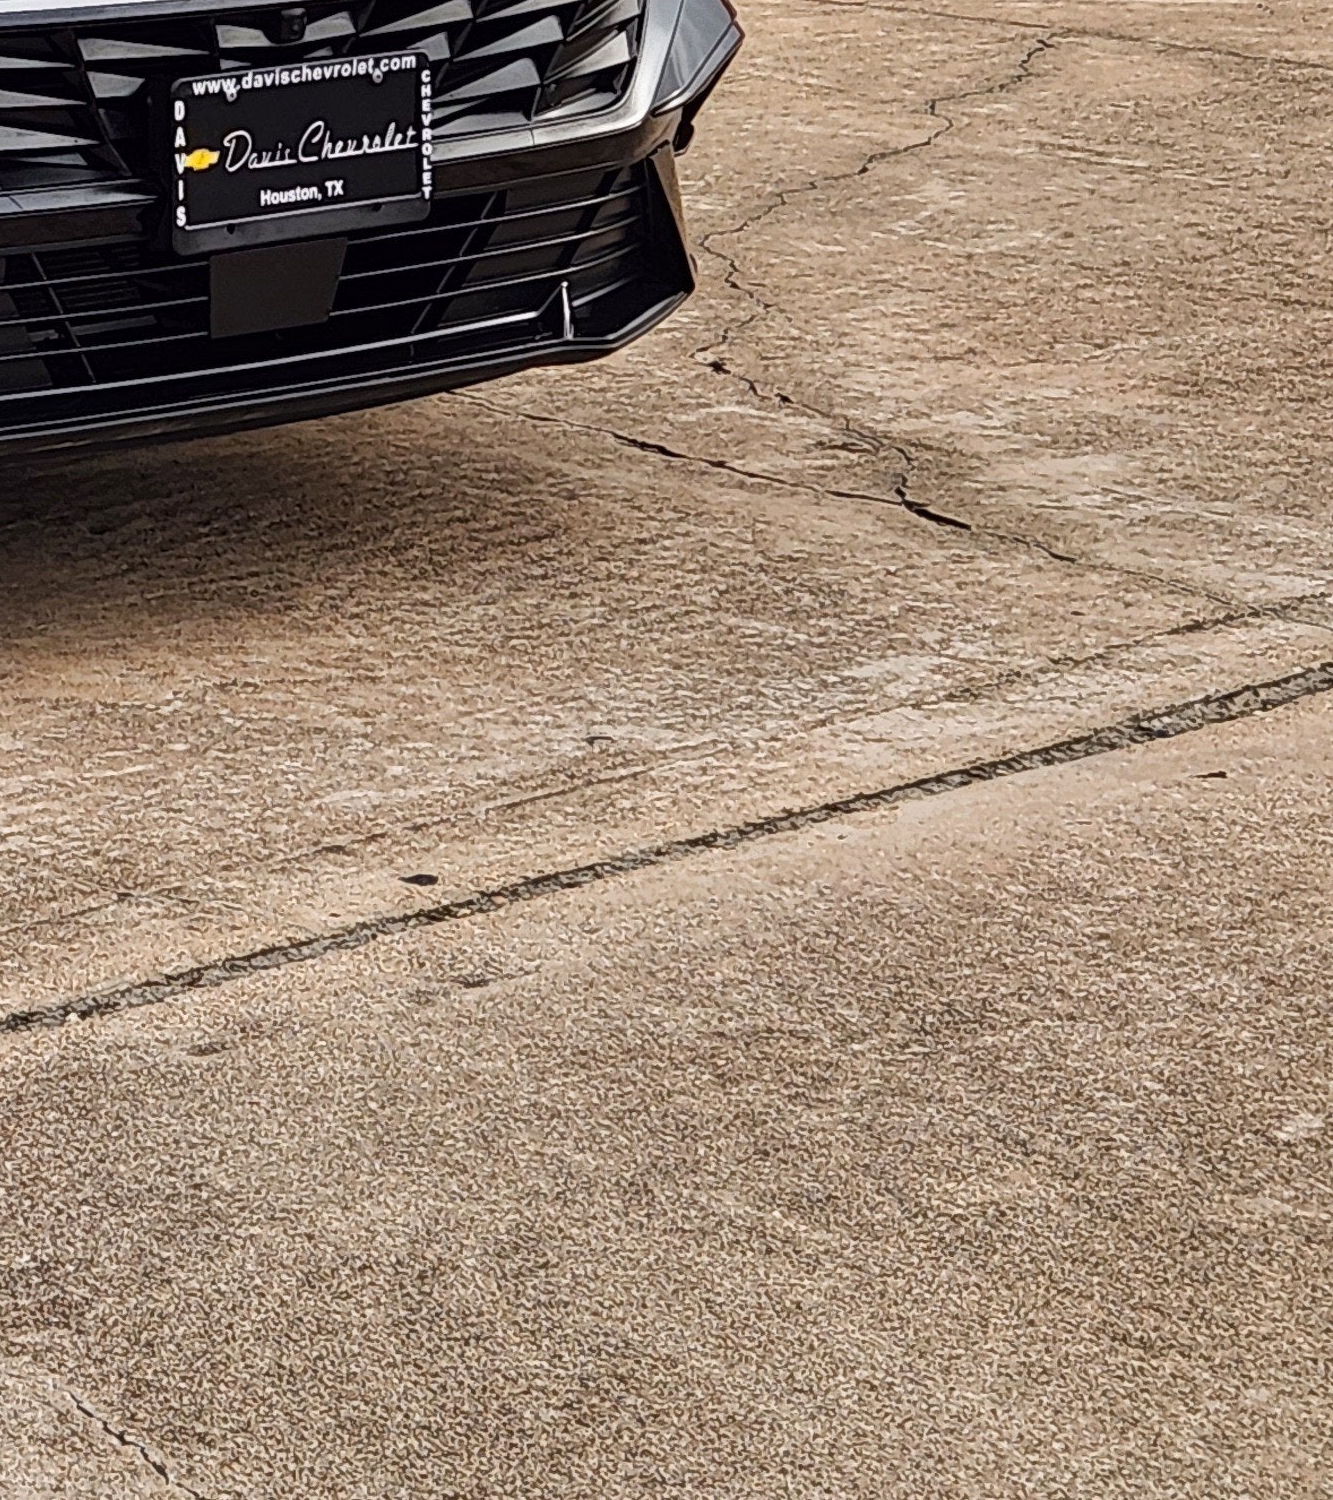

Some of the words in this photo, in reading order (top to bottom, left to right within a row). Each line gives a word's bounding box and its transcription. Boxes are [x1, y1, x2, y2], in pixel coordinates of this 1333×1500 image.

[192, 55, 416, 96] www.davischevrolet.com
[222, 129, 298, 173] Davis
[297, 120, 419, 163] Chevrolet
[421, 69, 433, 200] CHEVROLET
[174, 100, 187, 228] DAVIS
[259, 184, 322, 207] Houston,
[324, 180, 344, 198] TX
